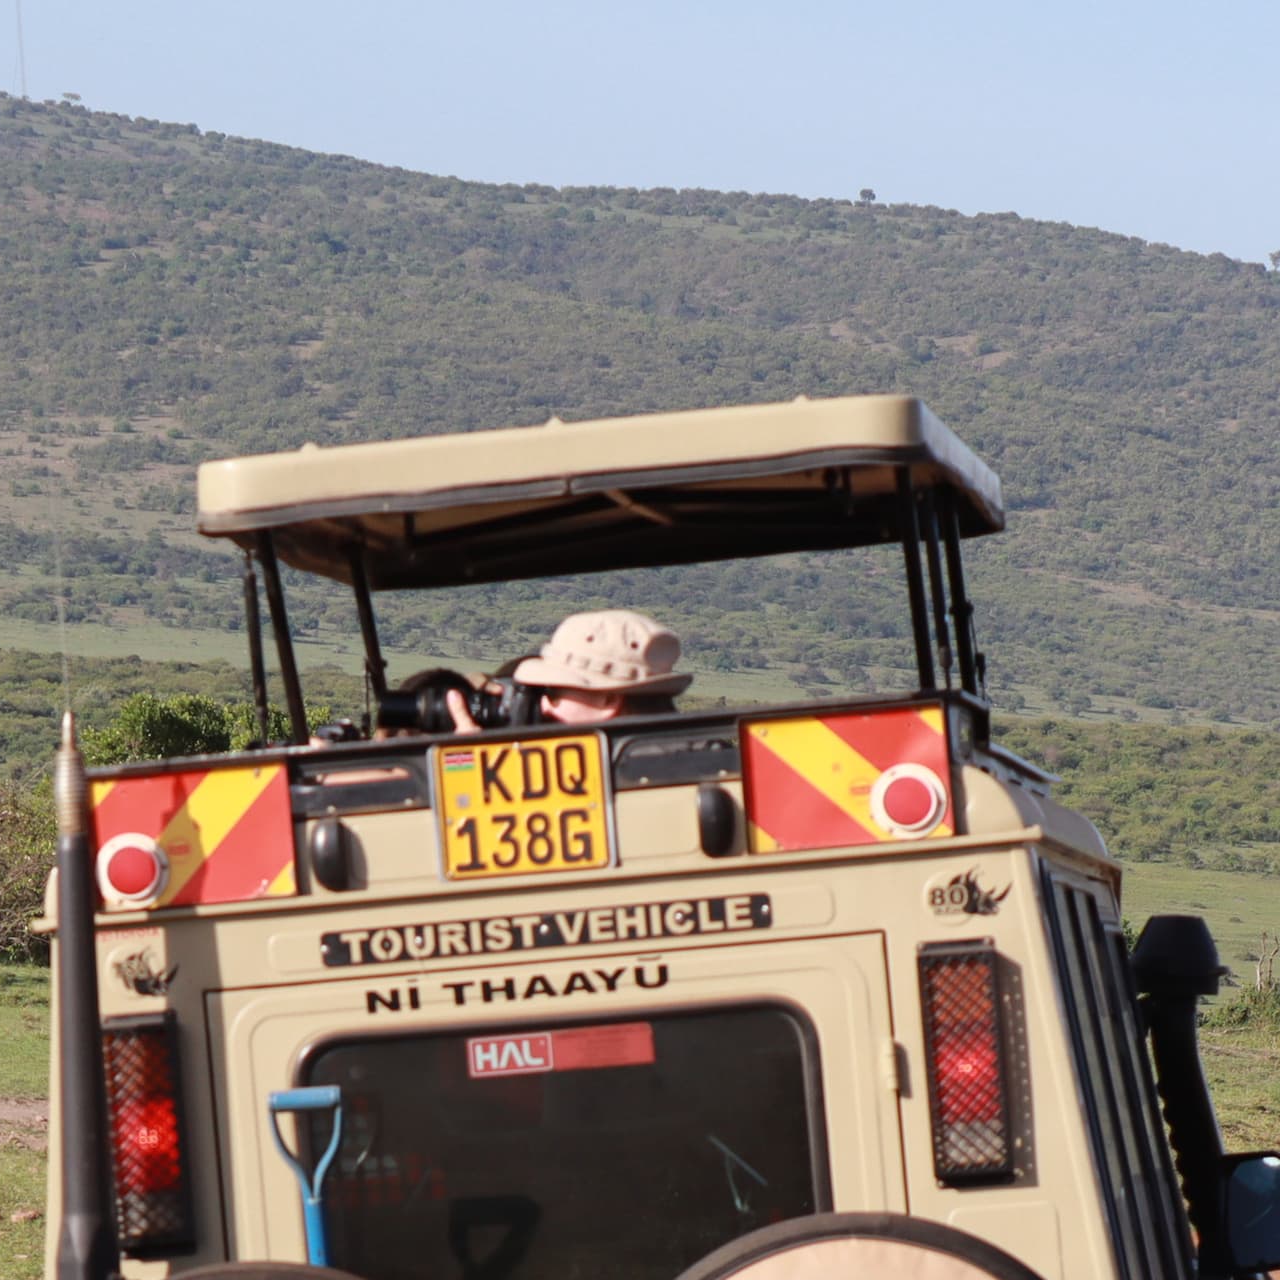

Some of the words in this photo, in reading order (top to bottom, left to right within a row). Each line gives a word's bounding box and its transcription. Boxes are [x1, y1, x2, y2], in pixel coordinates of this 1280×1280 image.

[480, 743, 587, 804] KDQ
[456, 809, 593, 872] 138G
[340, 914, 542, 964] TOURIST
[556, 896, 753, 944] VEHICLE
[475, 1039, 545, 1071] HAL
